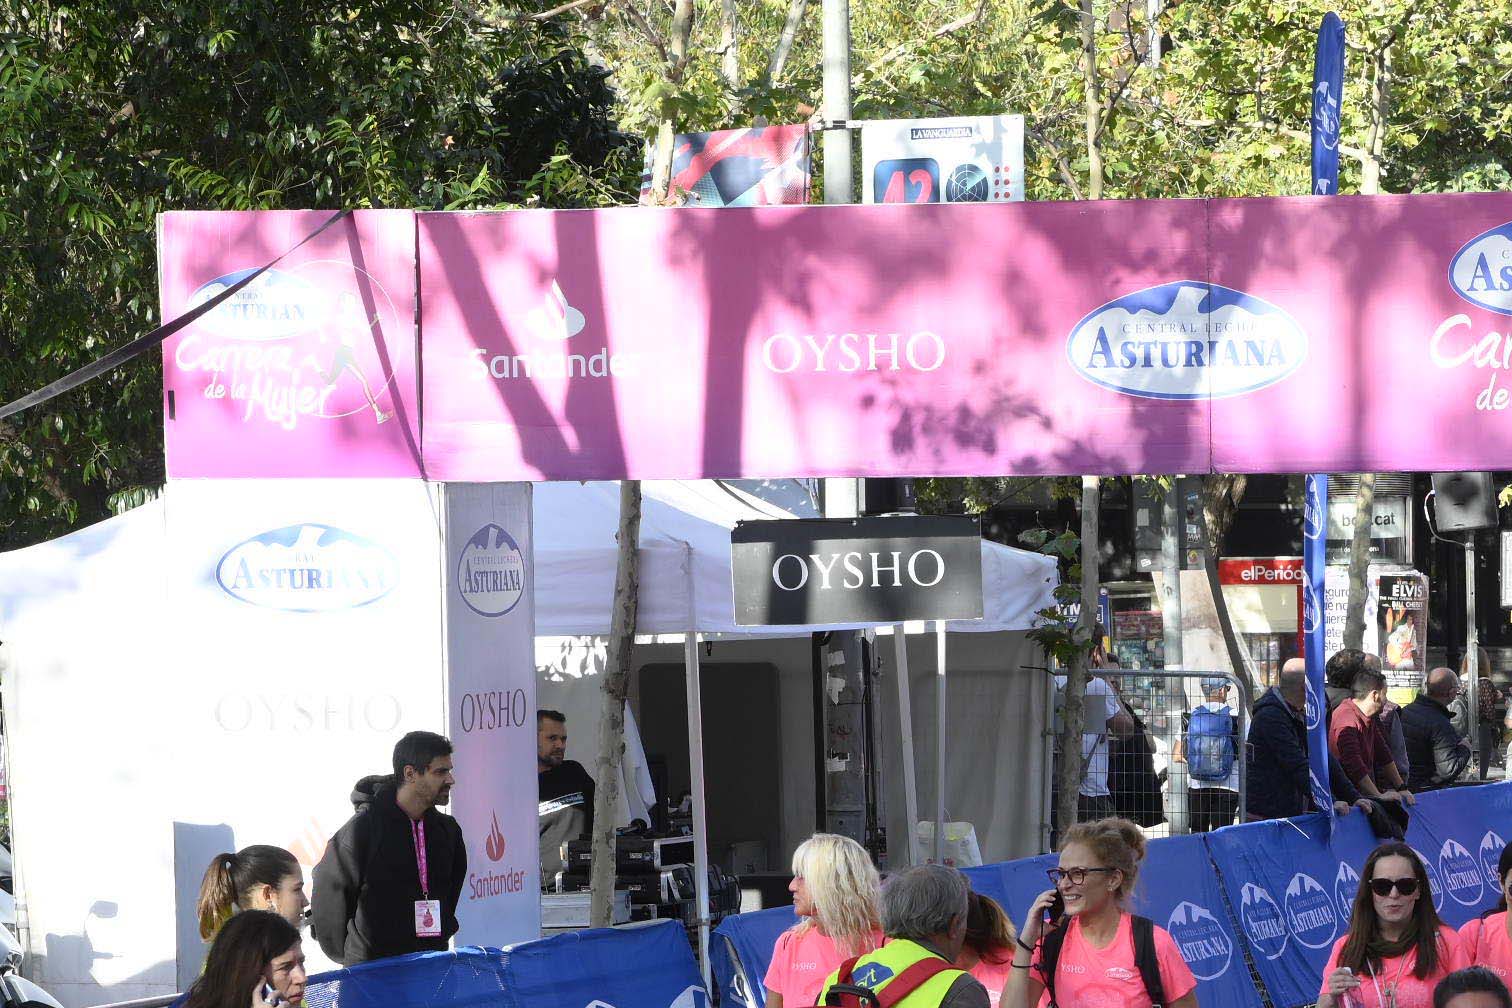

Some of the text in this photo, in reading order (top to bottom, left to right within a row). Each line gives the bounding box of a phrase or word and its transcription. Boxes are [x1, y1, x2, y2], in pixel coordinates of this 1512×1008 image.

[1122, 322, 1198, 334] CENTRAL
[174, 334, 298, 374] Carrera
[468, 346, 640, 380] Santander
[762, 332, 946, 374] OYSHO
[1086, 326, 1288, 370] ASTURIANA
[204, 376, 226, 400] de
[242, 366, 336, 430] Mujer
[1476, 372, 1510, 412] de
[231, 556, 388, 591] ASTURIANA
[462, 559, 521, 594] ASTURIANA
[772, 549, 945, 591] OYSHO
[1240, 564, 1304, 582] elPerióc
[1392, 584, 1423, 597] ELVIS
[214, 690, 402, 732] OYSHO
[460, 688, 527, 732] OYSHO
[468, 868, 525, 900] Santander
[1446, 868, 1482, 891] ASTURIANA
[1290, 904, 1335, 934] ASTURIANA
[1060, 962, 1086, 974] YSHO
